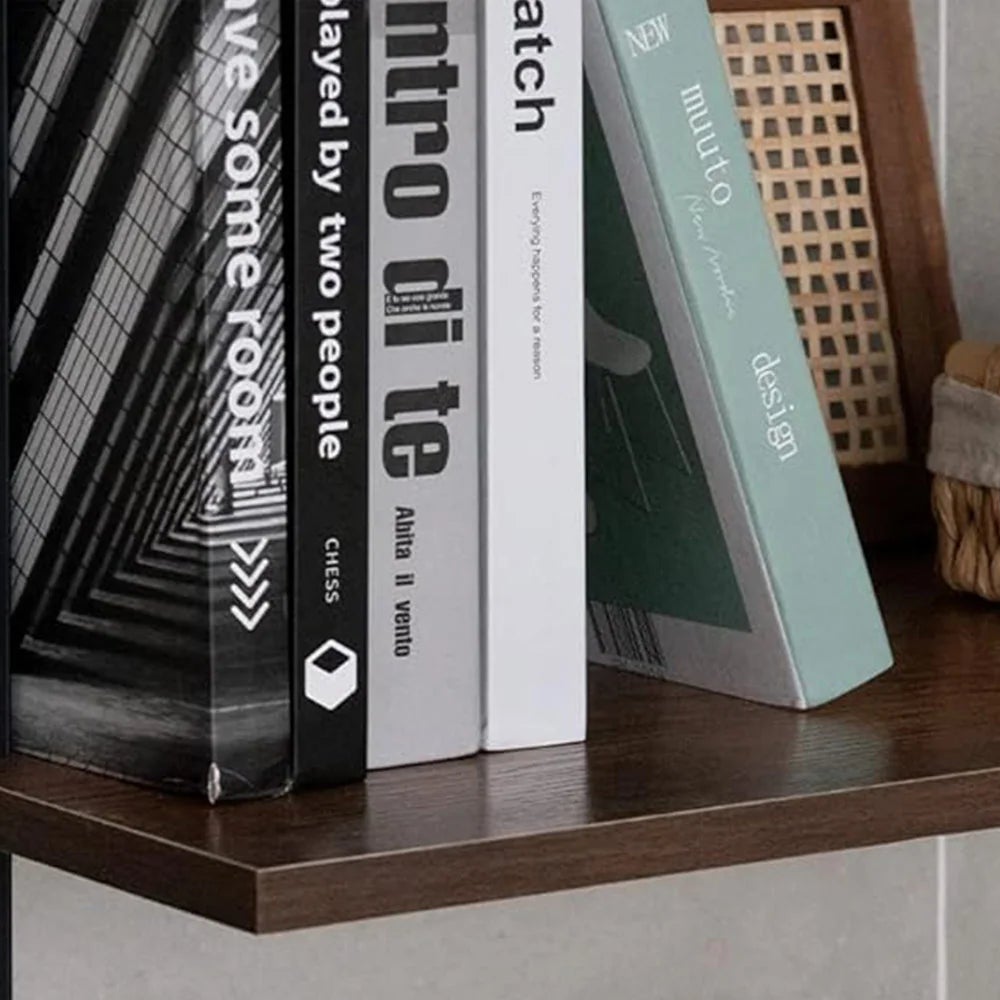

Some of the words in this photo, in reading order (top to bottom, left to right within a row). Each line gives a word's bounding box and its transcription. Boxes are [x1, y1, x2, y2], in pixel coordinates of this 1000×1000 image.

[224, 0, 259, 90] ve
[624, 13, 672, 57] NEW
[312, 141, 350, 192] by
[680, 84, 732, 206] muuto
[224, 109, 262, 289] some
[318, 213, 346, 298] two
[531, 248, 542, 302] happens
[383, 258, 463, 347] di
[532, 305, 542, 322] for
[532, 325, 541, 334] a
[312, 311, 350, 460] people
[532, 336, 542, 380] reason
[226, 311, 265, 484] room
[383, 381, 459, 478] te
[751, 352, 799, 461] design
[324, 537, 340, 604] CHESS
[394, 574, 415, 587] il
[394, 601, 415, 657] vento
